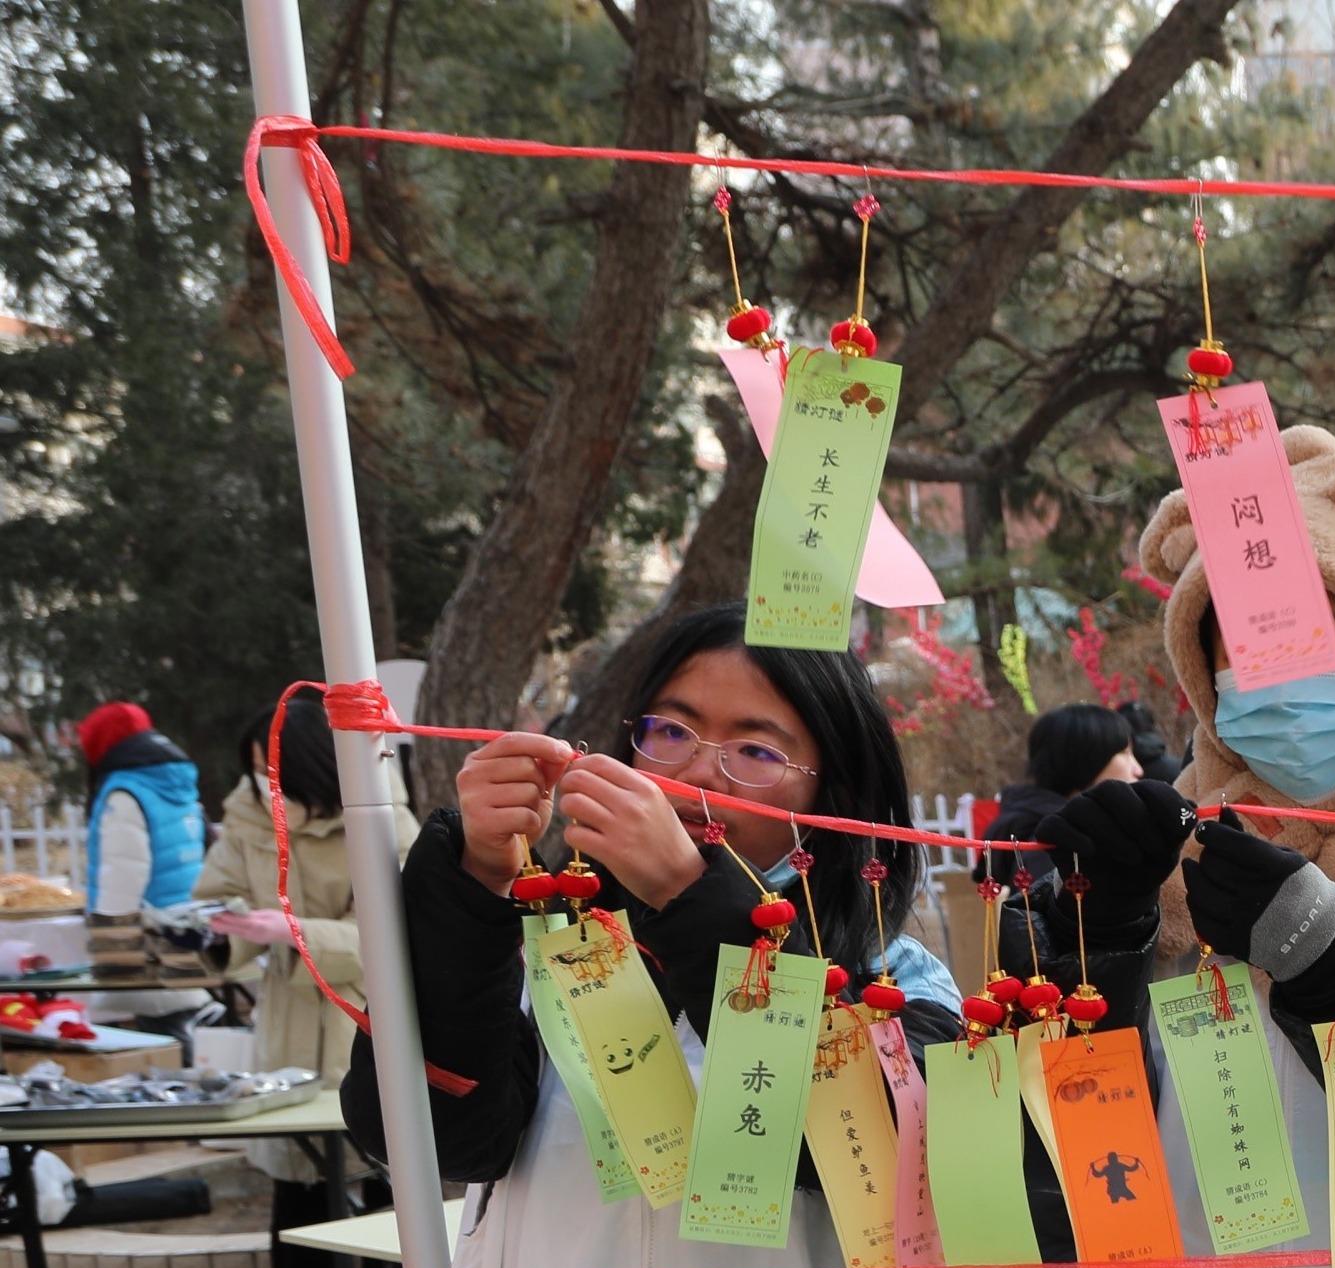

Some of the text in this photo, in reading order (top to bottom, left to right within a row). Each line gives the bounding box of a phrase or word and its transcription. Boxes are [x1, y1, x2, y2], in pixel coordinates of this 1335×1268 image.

[798, 448, 840, 549] 长生不老
[1231, 495, 1277, 570] 闷想
[569, 980, 606, 998] 猜灯谜
[734, 1060, 776, 1137] 赤兔
[1213, 1050, 1251, 1171] 扫除所有蜘蛛网
[840, 1109, 878, 1195] 但爱鲈鱼美
